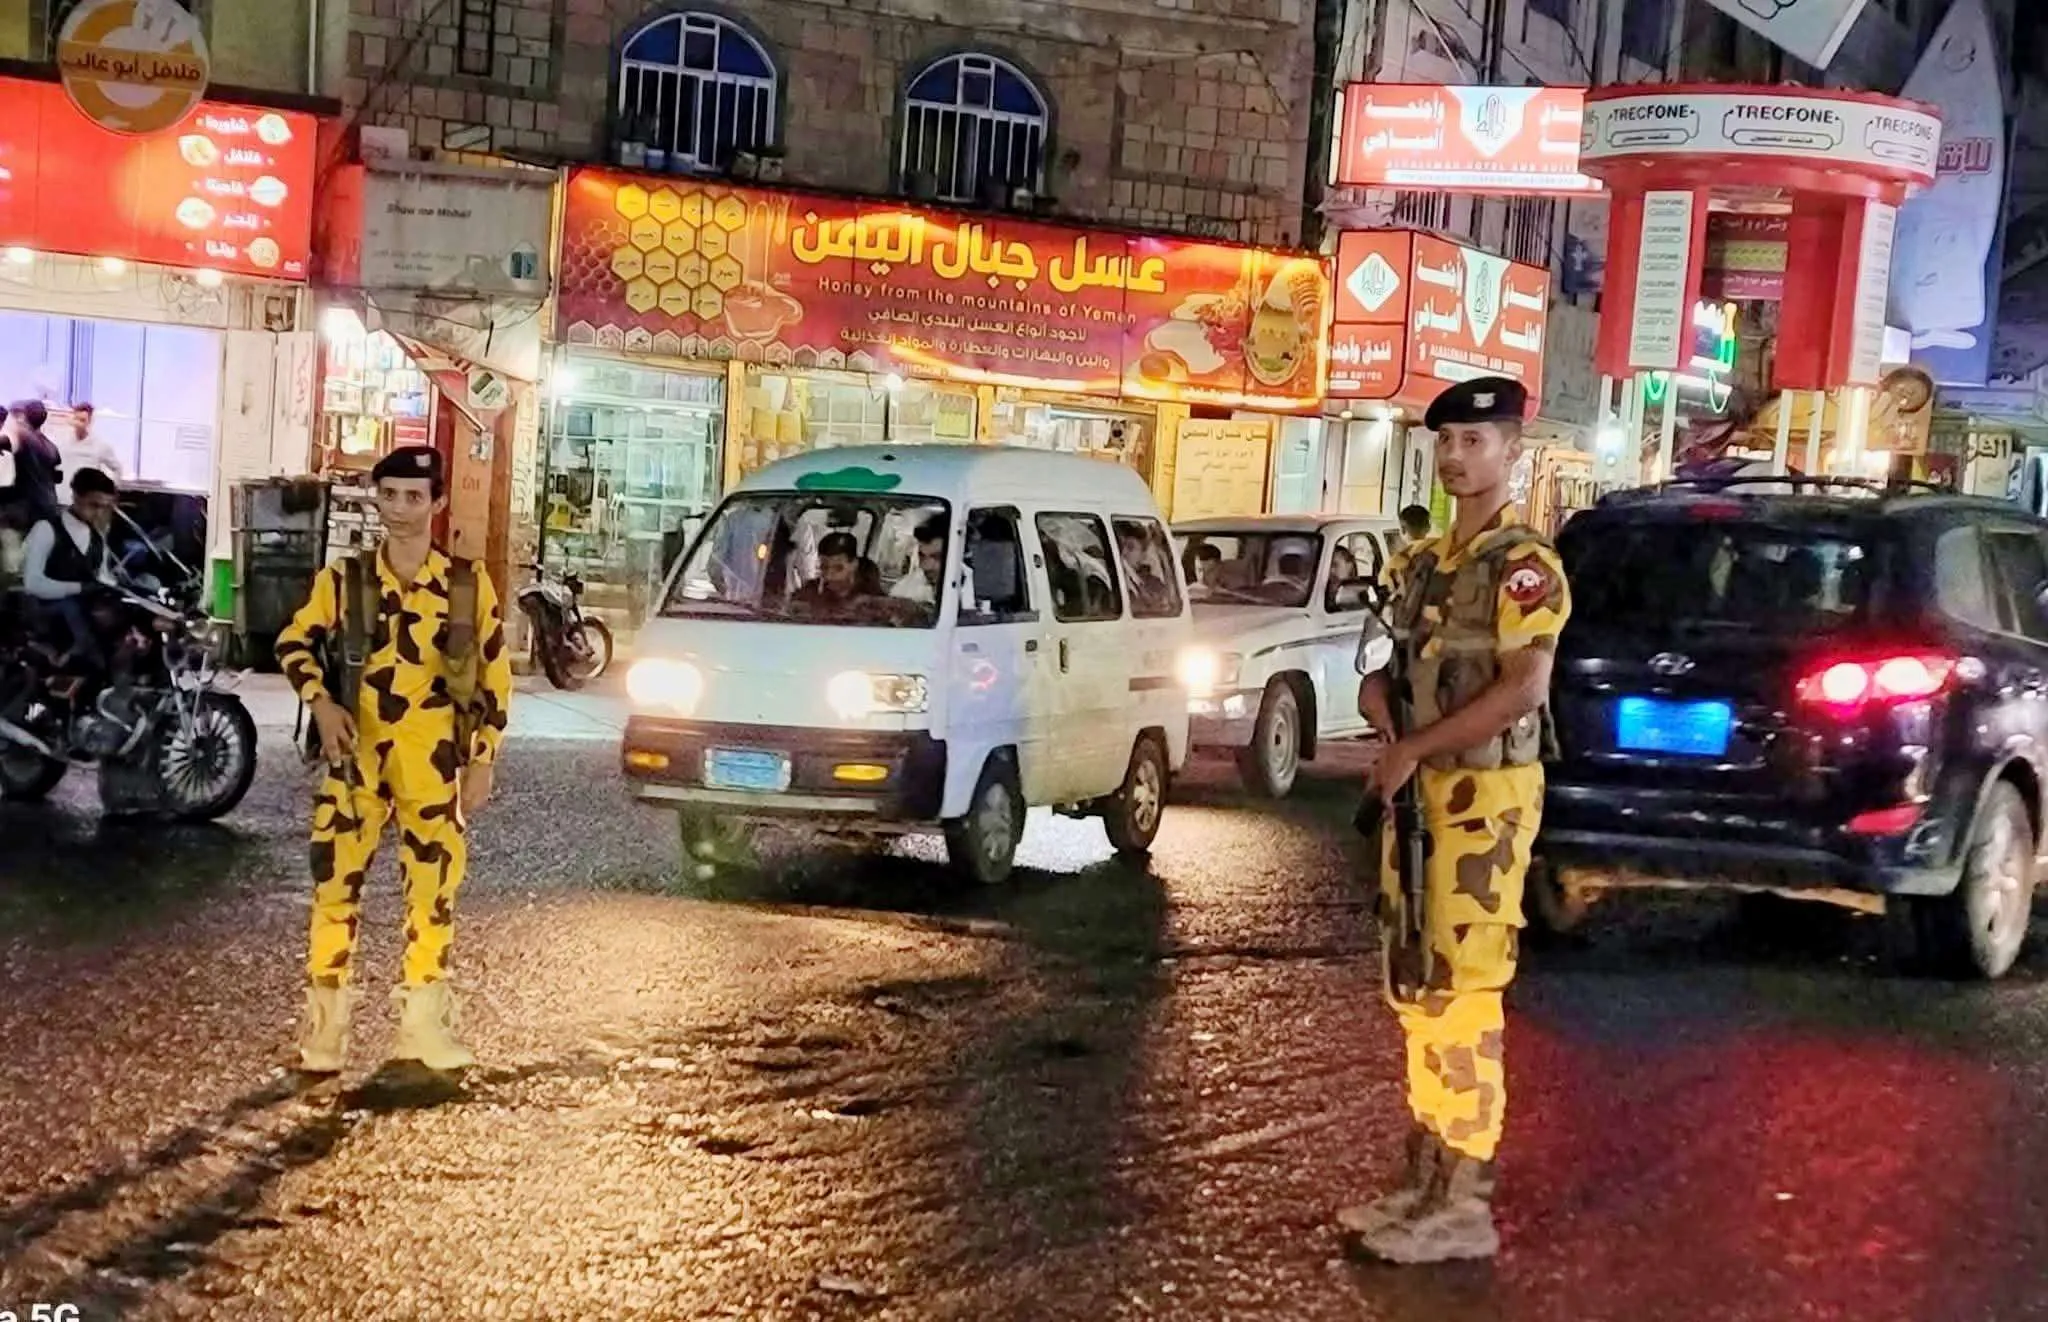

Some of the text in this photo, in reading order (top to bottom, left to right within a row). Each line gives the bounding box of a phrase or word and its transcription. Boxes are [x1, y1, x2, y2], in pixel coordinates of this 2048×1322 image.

[1613, 104, 1690, 121] TRECFONE
[1735, 105, 1835, 124] TRECFONE
[1875, 116, 1934, 140] TRECFONE
[792, 209, 925, 276] اليمن
[931, 220, 1039, 292] جبال
[1049, 236, 1167, 293] عسل
[819, 276, 1137, 324] Honey from the mountains of Yemen
[867, 307, 919, 325] الصافي
[921, 311, 965, 329] البلدي
